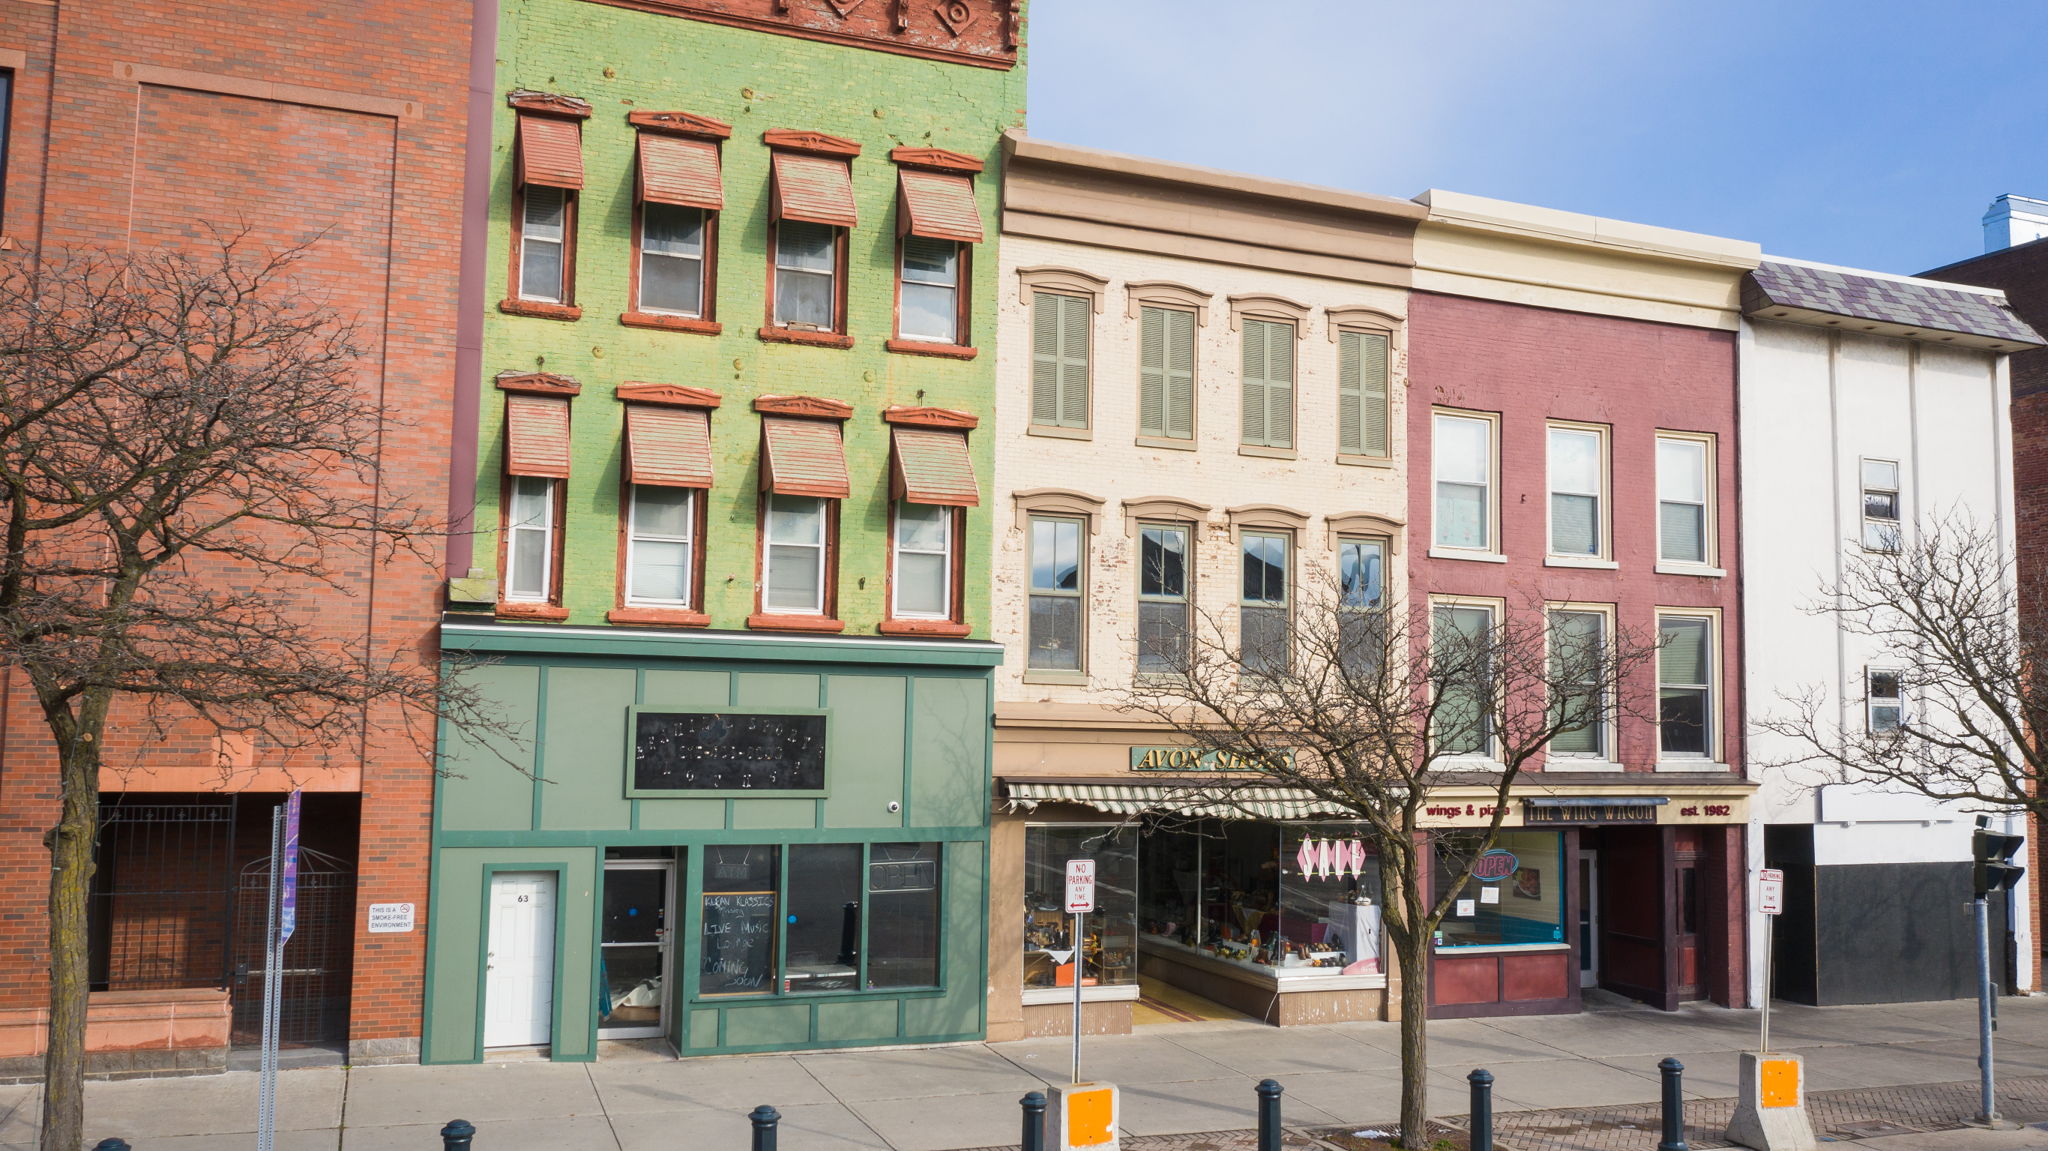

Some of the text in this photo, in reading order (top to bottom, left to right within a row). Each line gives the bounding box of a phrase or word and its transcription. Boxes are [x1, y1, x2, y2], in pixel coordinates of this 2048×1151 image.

[1137, 749, 1201, 769] AVON
[1426, 804, 1462, 819] wings
[1465, 804, 1475, 816] &
[1529, 804, 1653, 821] THE WING WAGON
[1703, 805, 1731, 816] 1982
[1302, 837, 1362, 877] SALE
[1075, 863, 1086, 873] NO
[1475, 856, 1513, 877] OPEN
[870, 864, 934, 888] OPEN
[1068, 875, 1093, 885] PARKING
[517, 895, 529, 903] 63
[704, 896, 730, 908] KLEAN
[704, 922, 731, 935] LIVE
